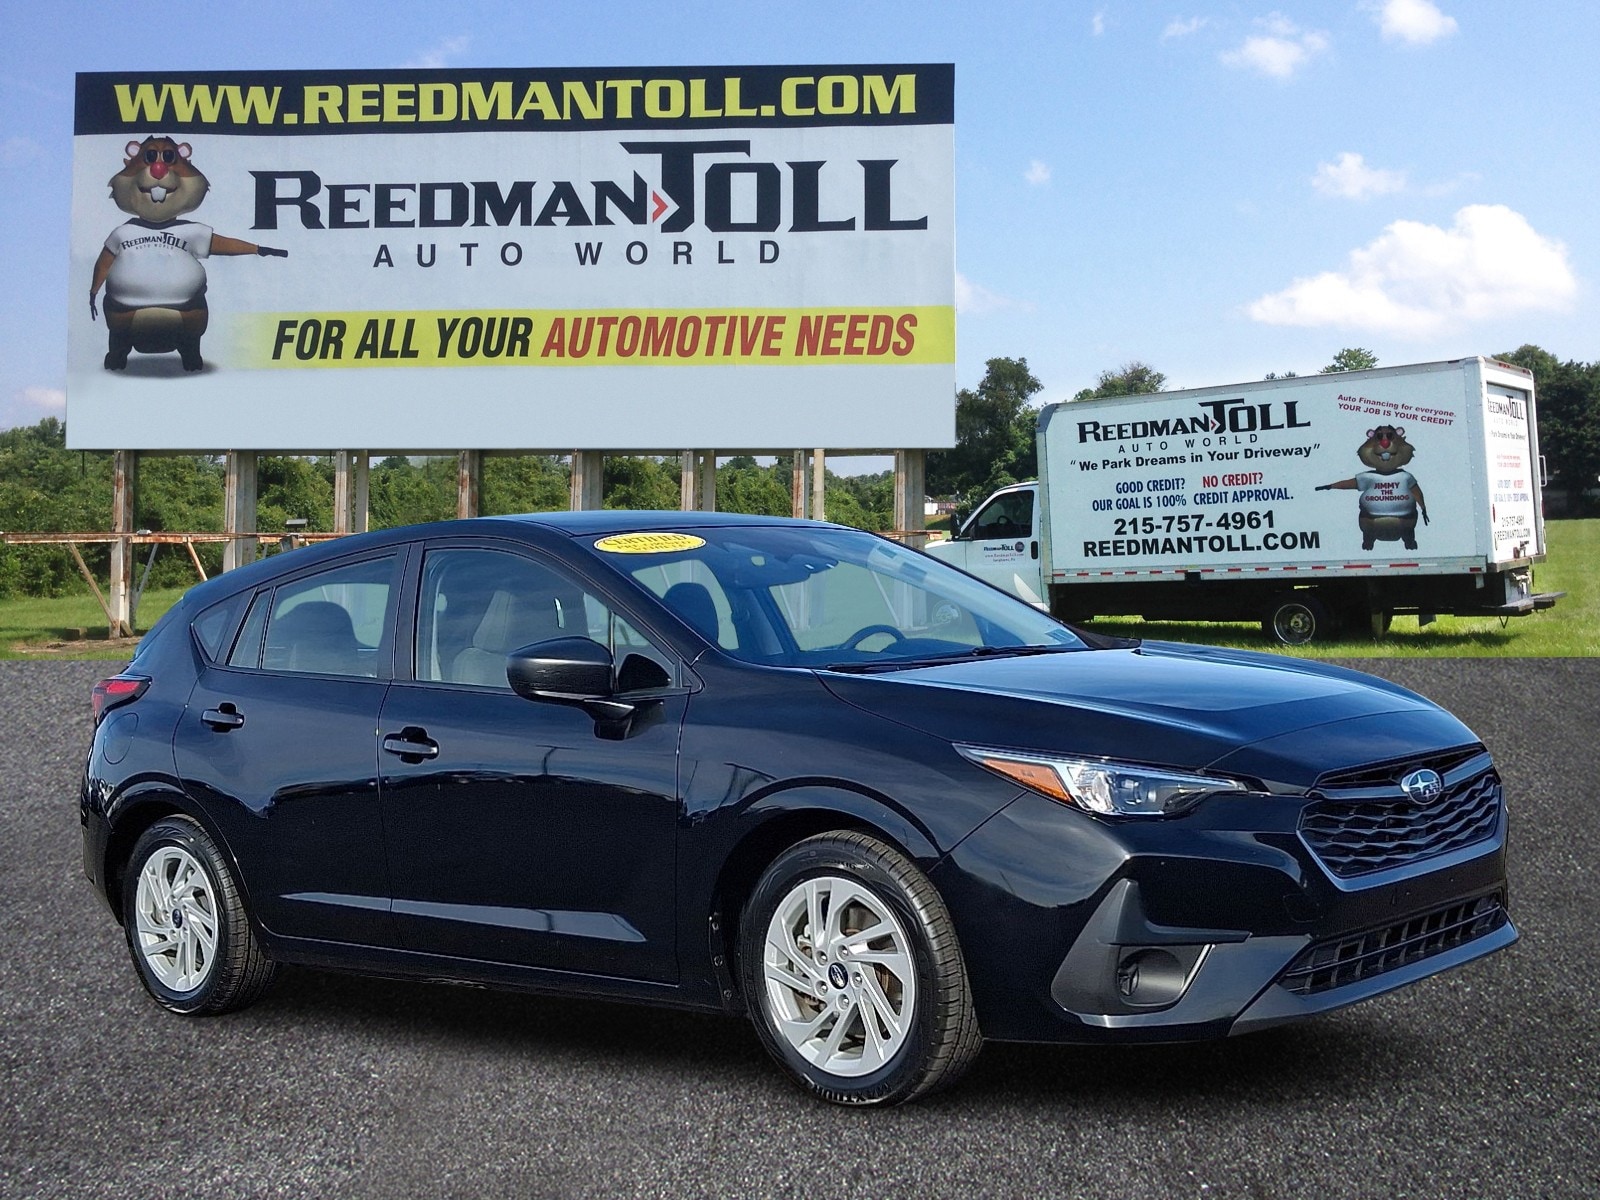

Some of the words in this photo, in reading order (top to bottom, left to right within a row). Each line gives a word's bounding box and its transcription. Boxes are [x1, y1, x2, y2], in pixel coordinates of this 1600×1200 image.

[113, 74, 917, 124] WWW.REEDMANTOLL.COM
[373, 242, 523, 268] AUTO
[574, 240, 780, 266] WORLD
[272, 319, 346, 360] FOR
[354, 318, 419, 359] ALL
[436, 317, 533, 359] YOUR
[541, 315, 787, 359] AUTOMOTIVE
[794, 313, 918, 357] NEEDS
[1337, 394, 1357, 403] Auto
[1359, 397, 1399, 410] Financing
[1401, 403, 1413, 411] for
[1338, 403, 1361, 412] YOUR
[1363, 407, 1381, 415] JOB
[1383, 409, 1391, 417] IS
[1394, 411, 1418, 421] YOUR
[1420, 415, 1454, 426] CREDIT
[1118, 441, 1168, 454] AUTO
[1184, 433, 1258, 449] WORLD
[1102, 458, 1132, 470] Park
[1135, 454, 1186, 467] Dreams
[1191, 452, 1203, 463] in
[1207, 450, 1240, 461] Your
[1116, 481, 1143, 494] GOOD
[1147, 477, 1186, 492] CREDIT?
[1202, 475, 1219, 488] NO
[1222, 472, 1264, 487] CREDIT?
[1373, 481, 1401, 490] JIMMY
[1092, 499, 1113, 511] OUR
[1116, 497, 1141, 510] GOAL
[1143, 496, 1152, 508] IS
[1156, 494, 1187, 508] 100%
[1193, 491, 1229, 505] CREDIT
[1232, 487, 1294, 503] APPROVAL.
[1365, 494, 1409, 502] GROUNDHOG
[1114, 510, 1274, 535] 215-757-4961
[1083, 531, 1320, 557] REEDMANTOLL.COM
